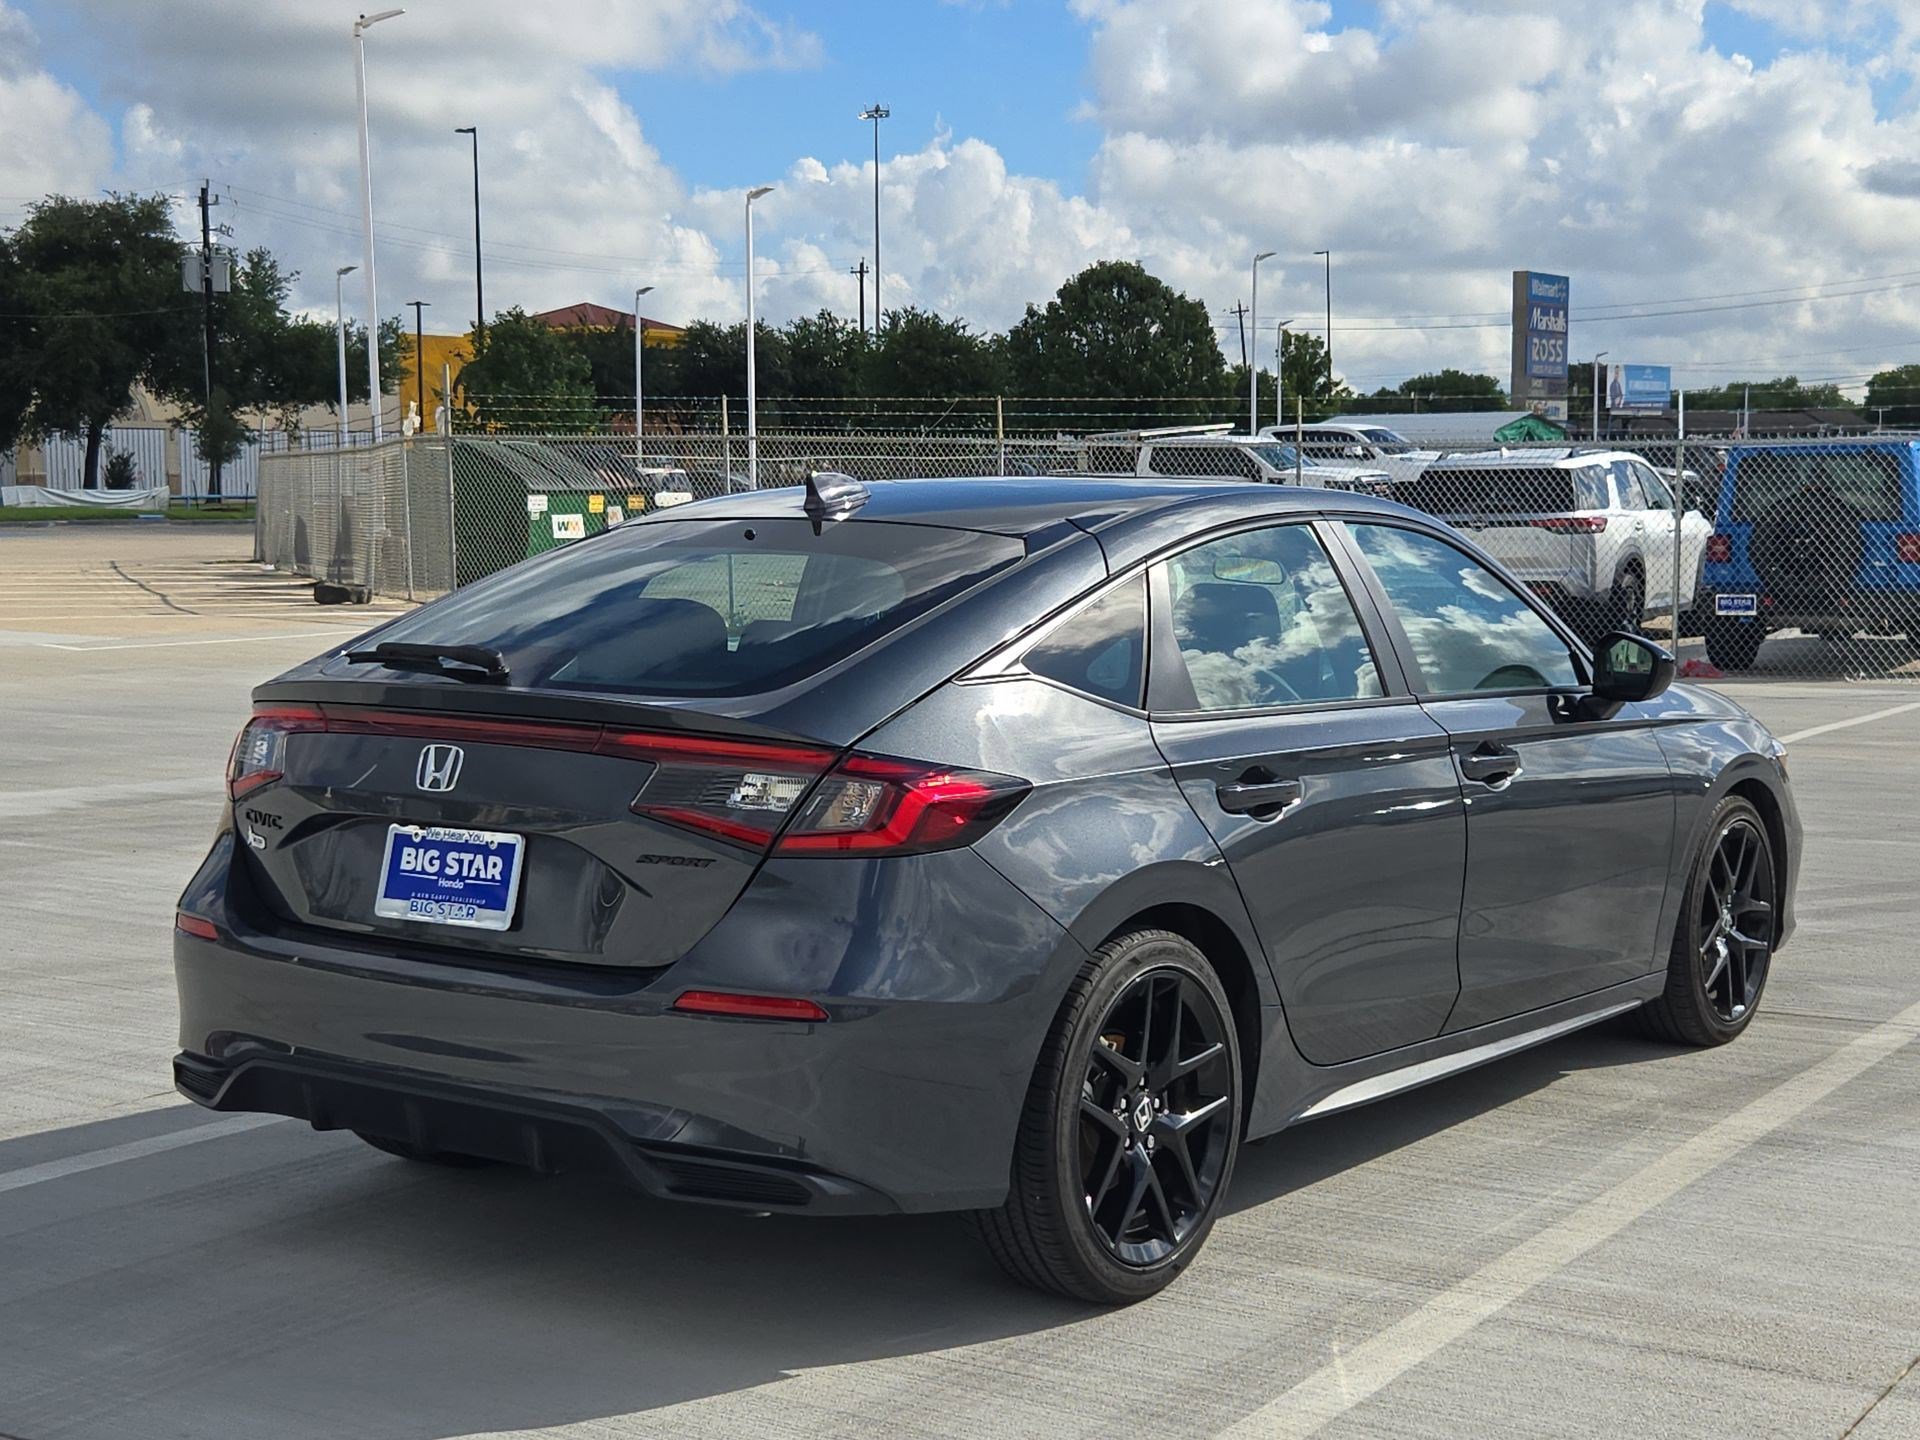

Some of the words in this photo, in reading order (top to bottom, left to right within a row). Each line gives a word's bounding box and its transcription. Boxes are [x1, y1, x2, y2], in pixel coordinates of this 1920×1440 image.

[1531, 278, 1559, 298] Walmart
[1530, 306, 1567, 333] Marshalls
[1532, 337, 1563, 363] ROSS
[246, 808, 283, 829] CIVIC
[426, 827, 441, 839] We
[443, 829, 466, 841] Hear
[400, 847, 440, 873] BIG
[445, 851, 503, 880] STAR
[636, 854, 717, 868] SPORT
[438, 877, 464, 890] Honda
[410, 900, 433, 914] BIG
[437, 902, 476, 918] STAR
